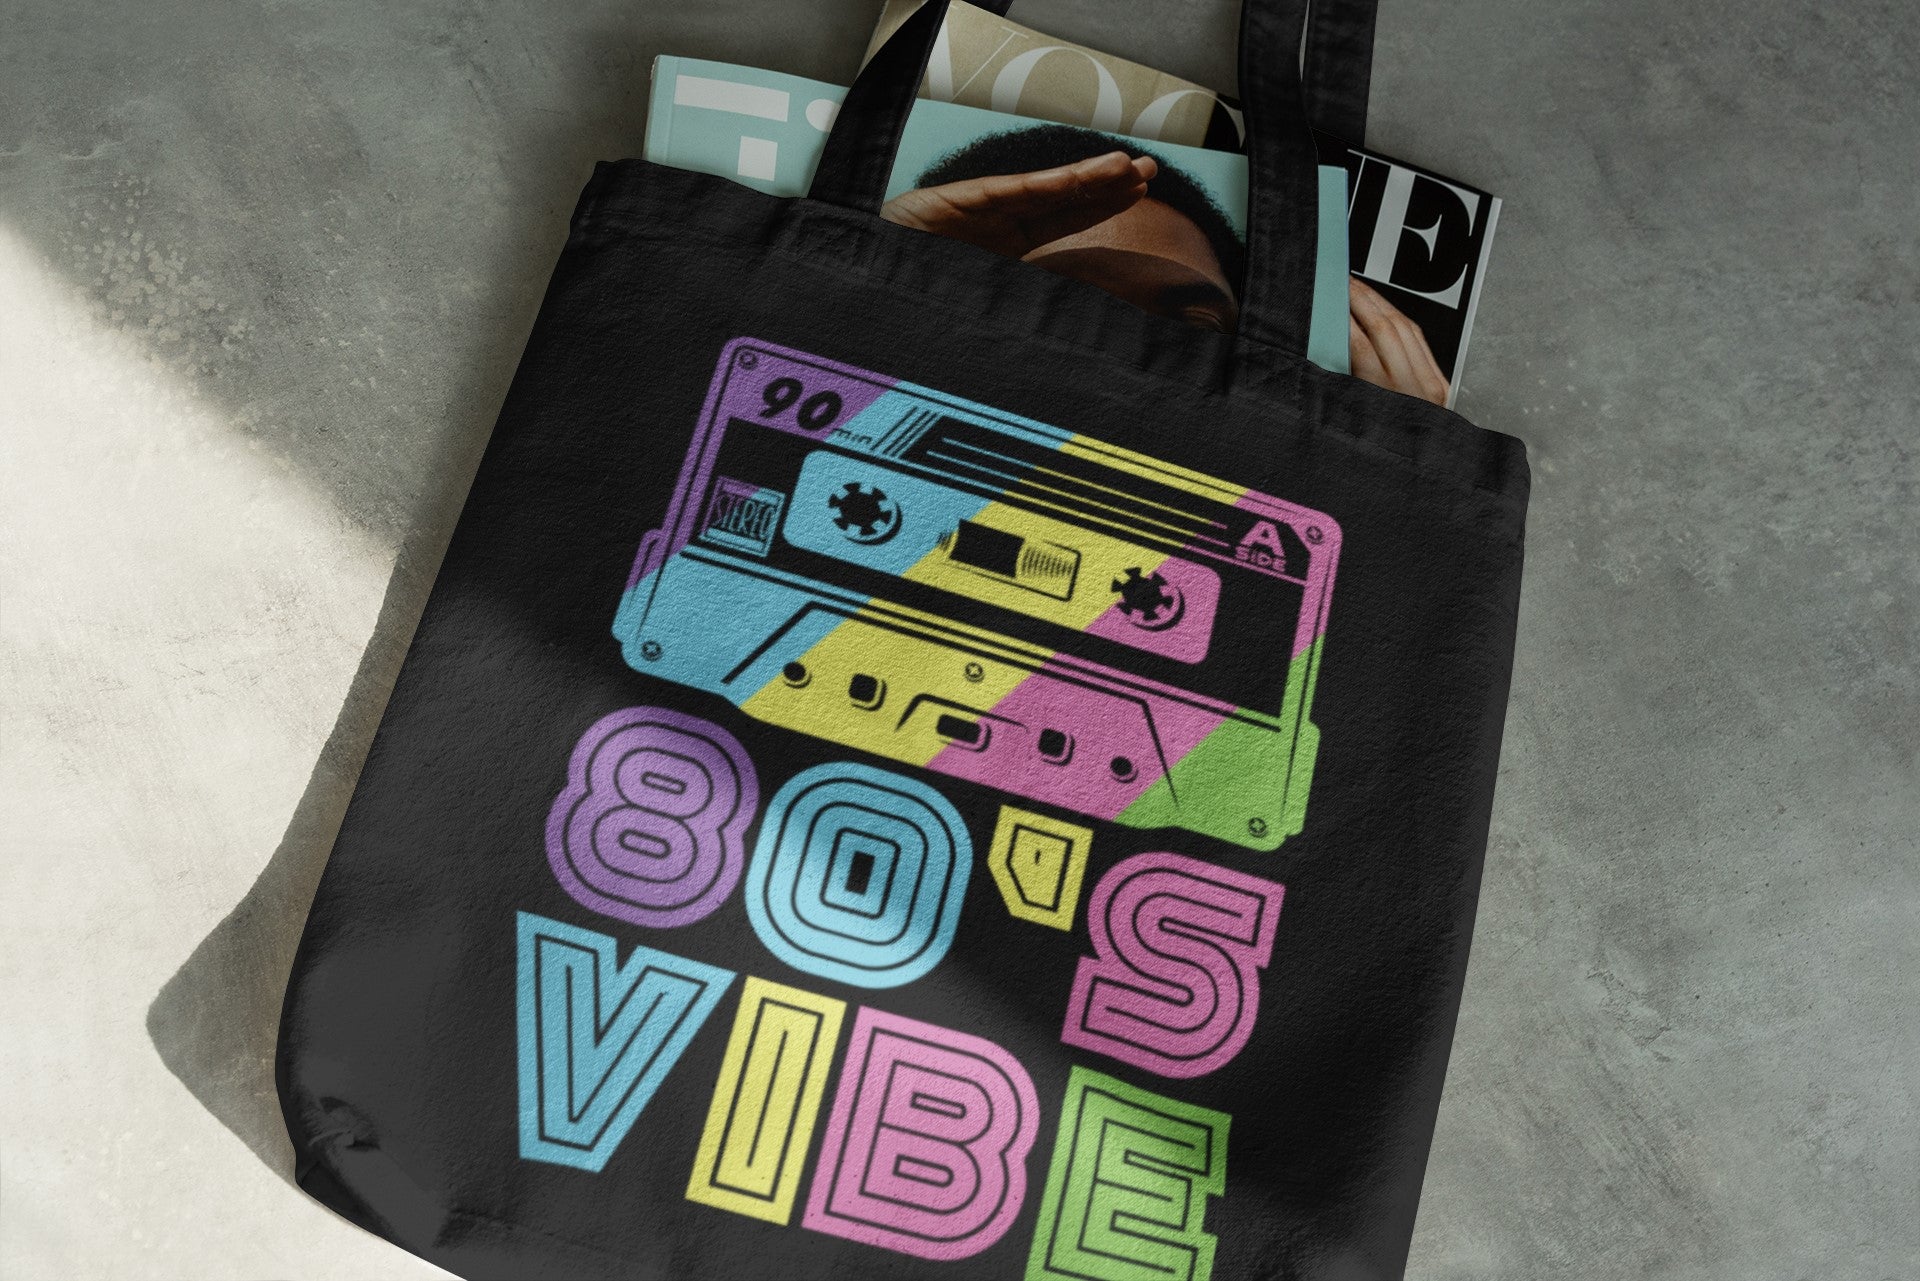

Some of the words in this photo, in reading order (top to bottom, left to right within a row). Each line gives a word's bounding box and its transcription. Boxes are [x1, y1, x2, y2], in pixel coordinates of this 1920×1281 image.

[759, 377, 843, 431] 90
[710, 493, 777, 541] STEREO
[1239, 520, 1286, 558] A
[544, 705, 1286, 1079] 80'S
[516, 911, 1232, 1281] VIBE
